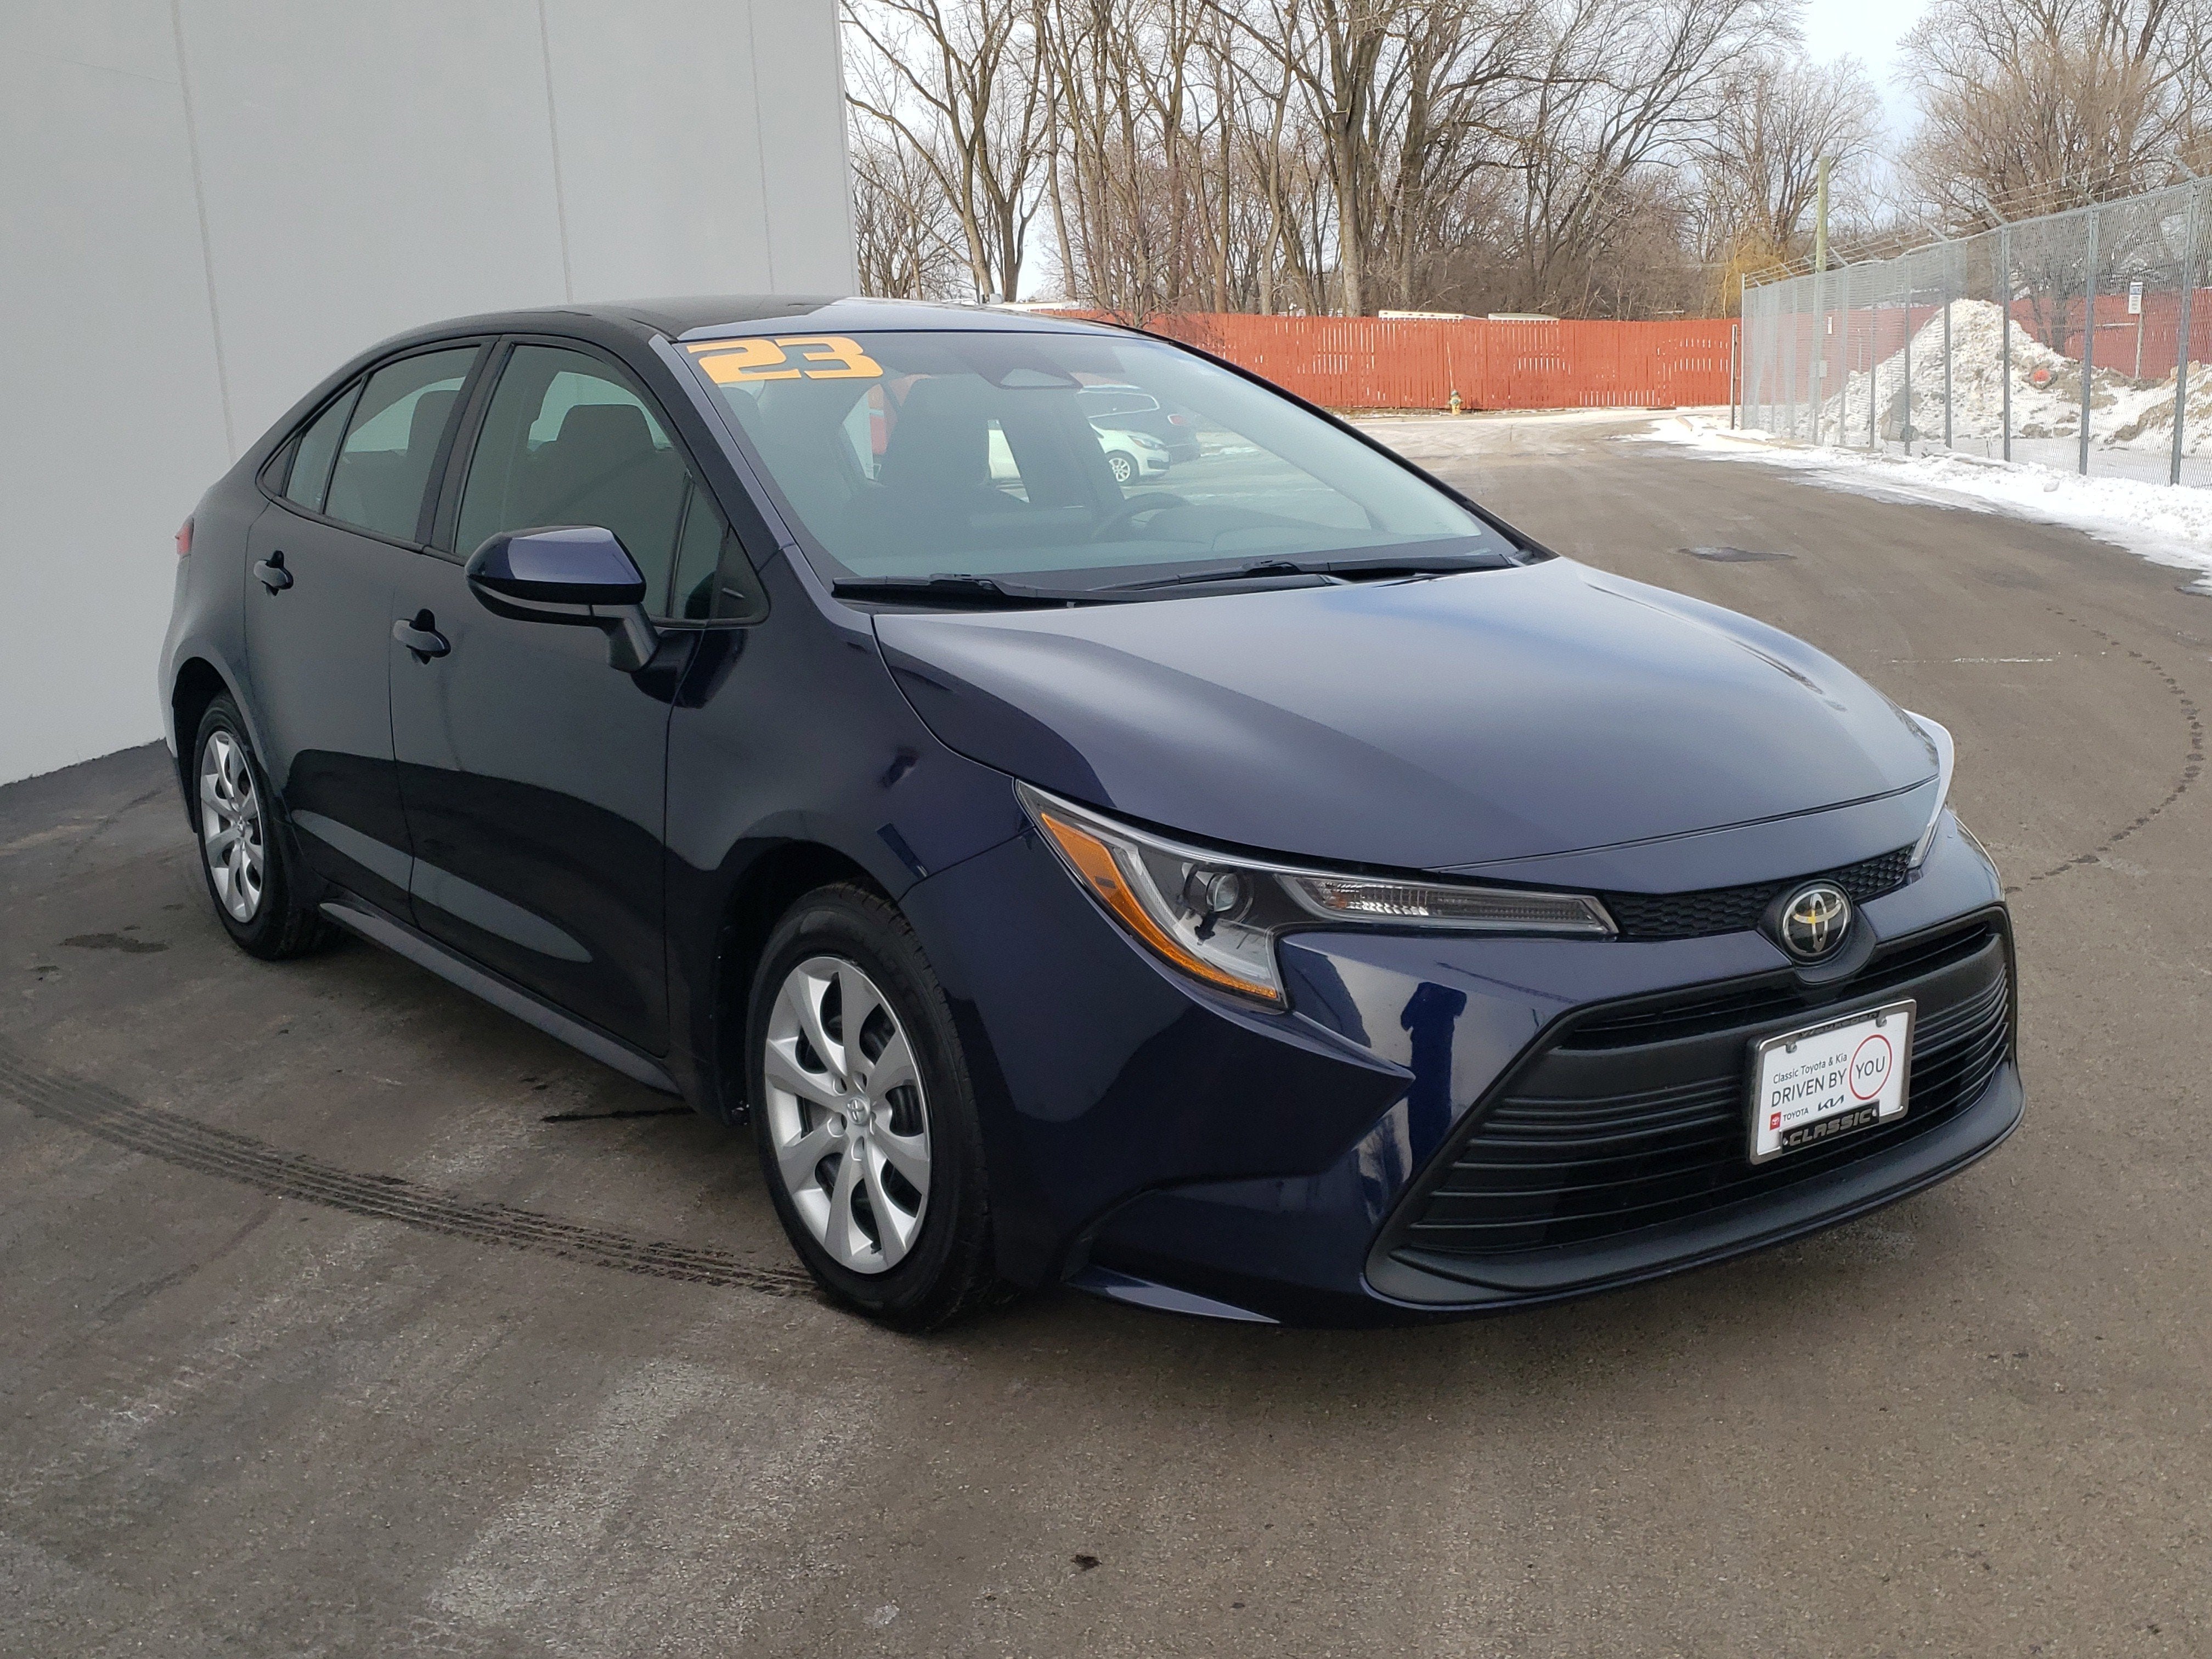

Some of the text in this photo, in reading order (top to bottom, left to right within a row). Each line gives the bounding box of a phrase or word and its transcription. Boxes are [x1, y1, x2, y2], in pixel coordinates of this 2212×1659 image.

[686, 336, 884, 384] 23
[1771, 1056, 1886, 1108] DRIVEN BY YOU
[1773, 1053, 1847, 1084] Classic Toyota & Kia
[1783, 1107, 1809, 1121] TOYOTA
[1789, 1107, 1873, 1147] CLASSIC
